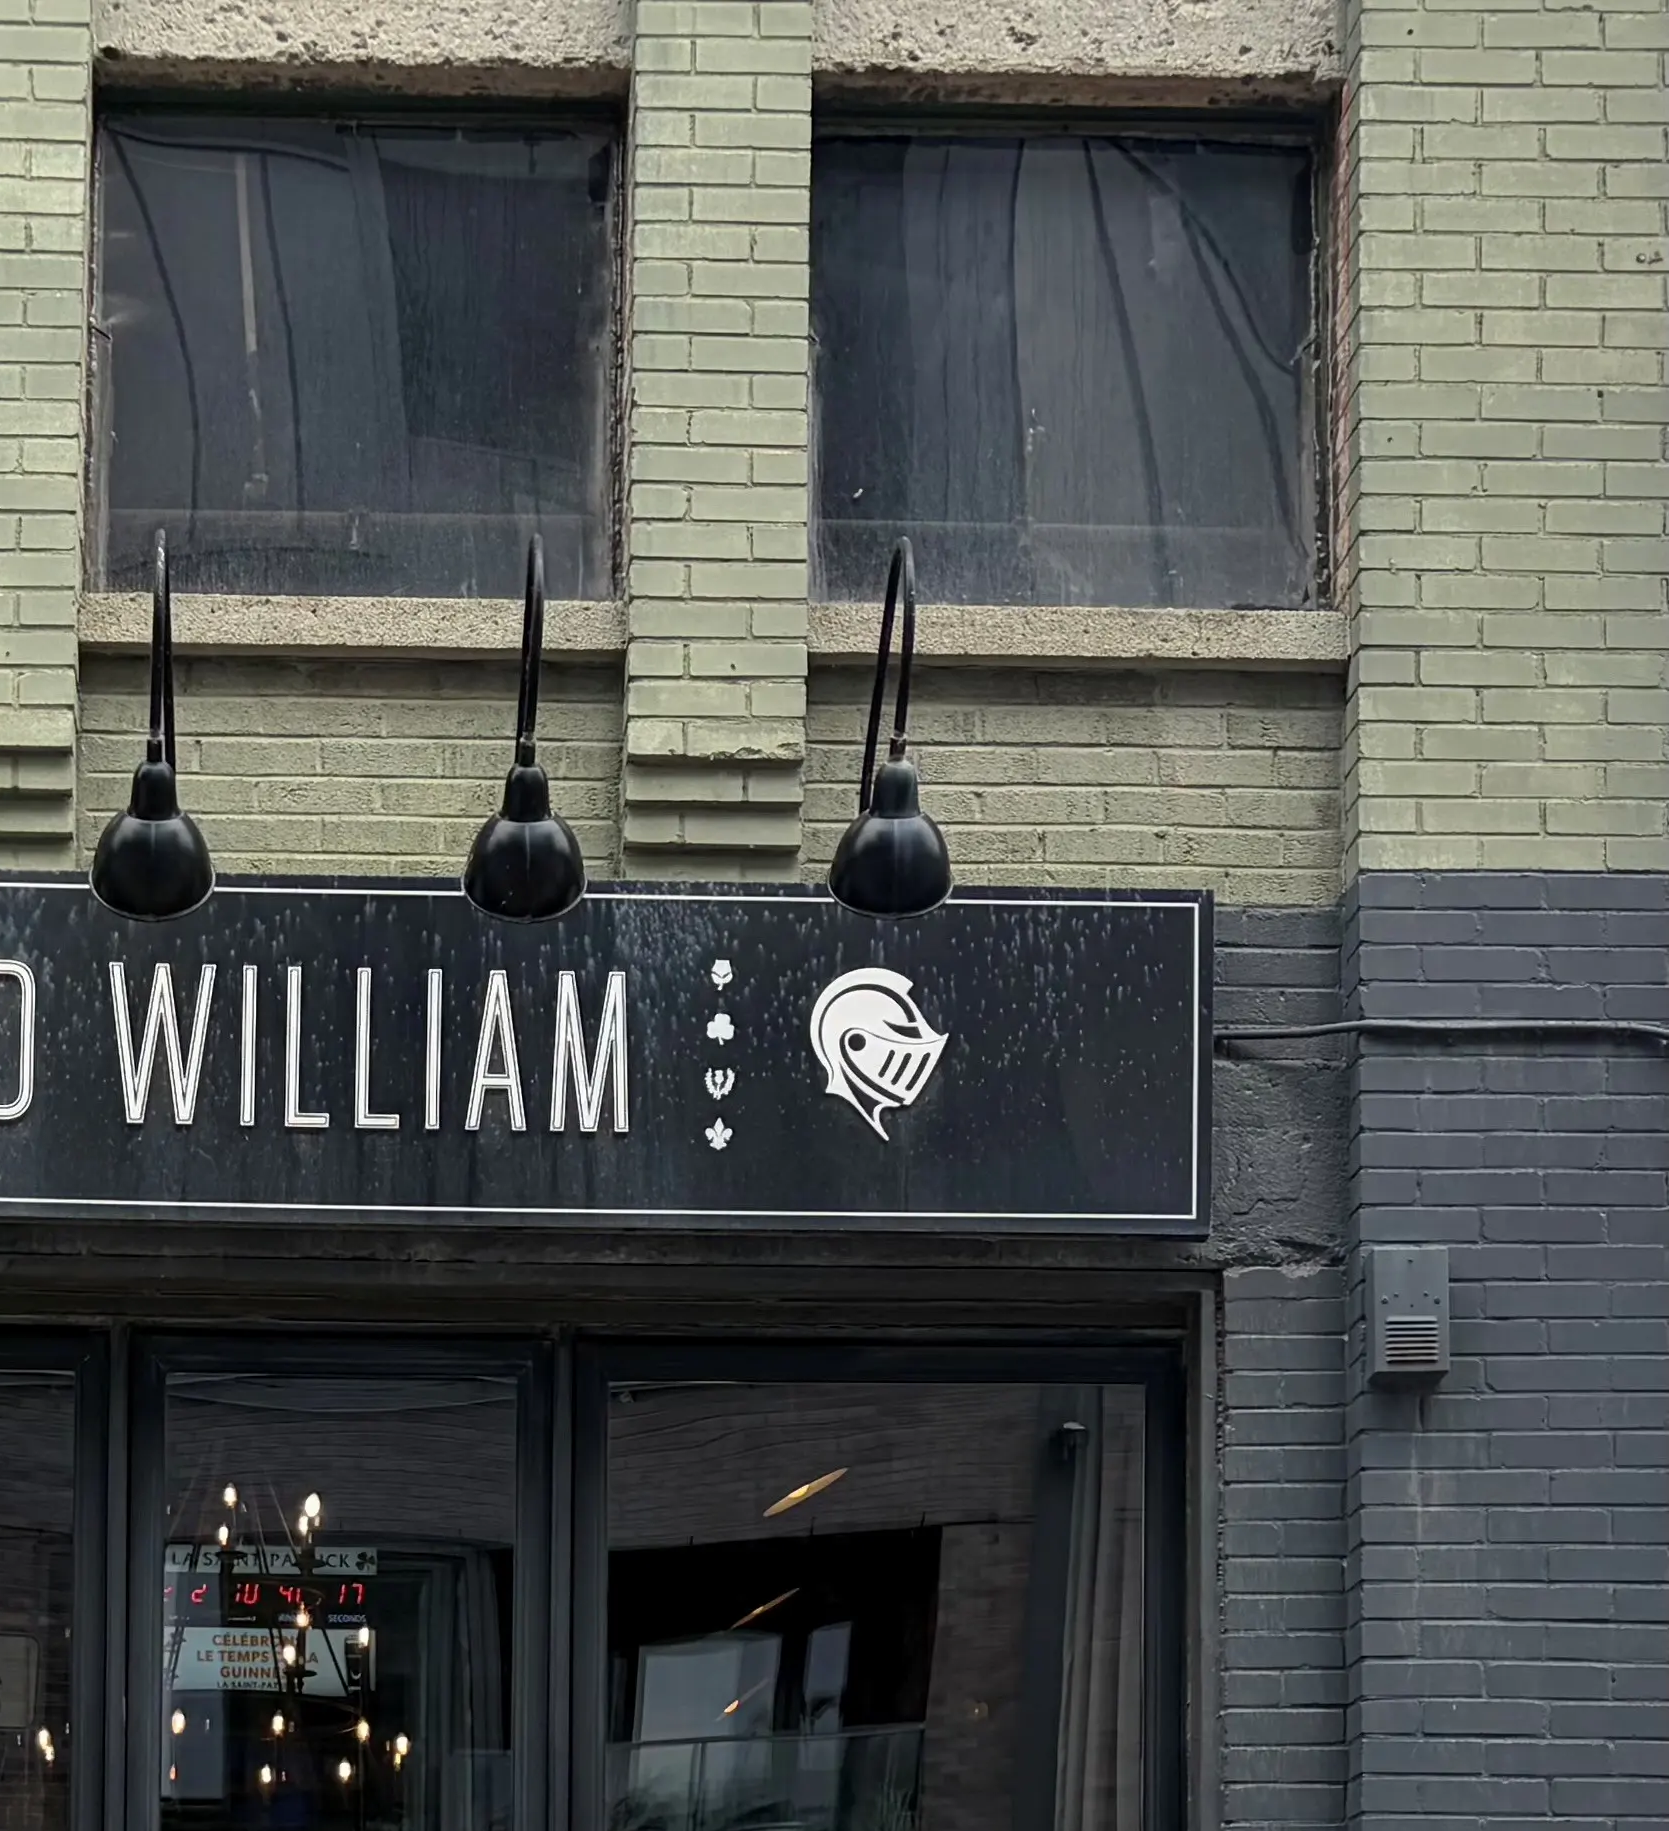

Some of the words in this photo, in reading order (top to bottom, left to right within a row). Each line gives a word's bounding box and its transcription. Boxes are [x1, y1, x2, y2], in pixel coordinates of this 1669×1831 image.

[108, 961, 630, 1133] WILLIAM
[270, 1552, 350, 1569] PACK
[339, 1583, 366, 1605] 17
[212, 1632, 300, 1648] CÉLÉBRON
[196, 1650, 214, 1662] LE
[220, 1650, 270, 1663] TEMPS
